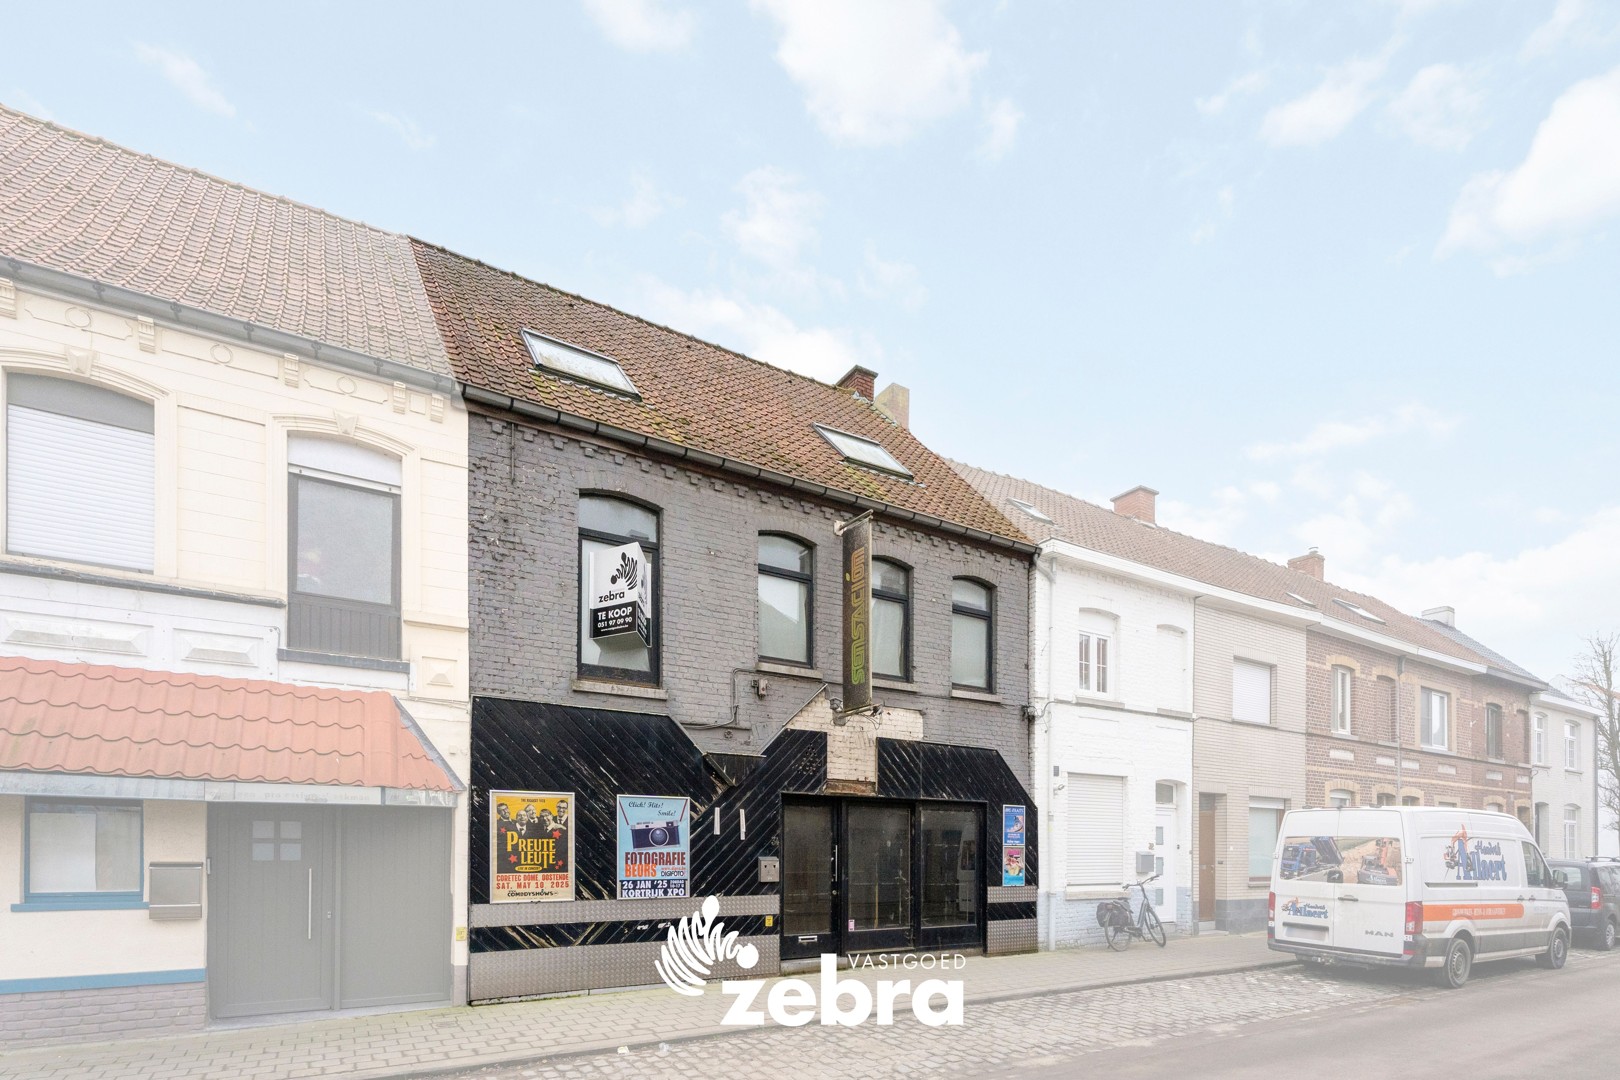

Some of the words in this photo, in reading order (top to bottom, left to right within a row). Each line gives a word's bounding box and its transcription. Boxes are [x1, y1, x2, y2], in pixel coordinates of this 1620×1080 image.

[598, 590, 625, 603] zebra
[598, 611, 606, 620] TE
[608, 606, 632, 618] KOOP
[506, 831, 556, 852] PREUTE
[521, 851, 556, 868] LEUTE
[625, 852, 686, 865] FOTOGRAFIE
[625, 864, 657, 877] BEURS
[622, 889, 664, 898] KORTRIJK
[1364, 929, 1395, 938] MAN
